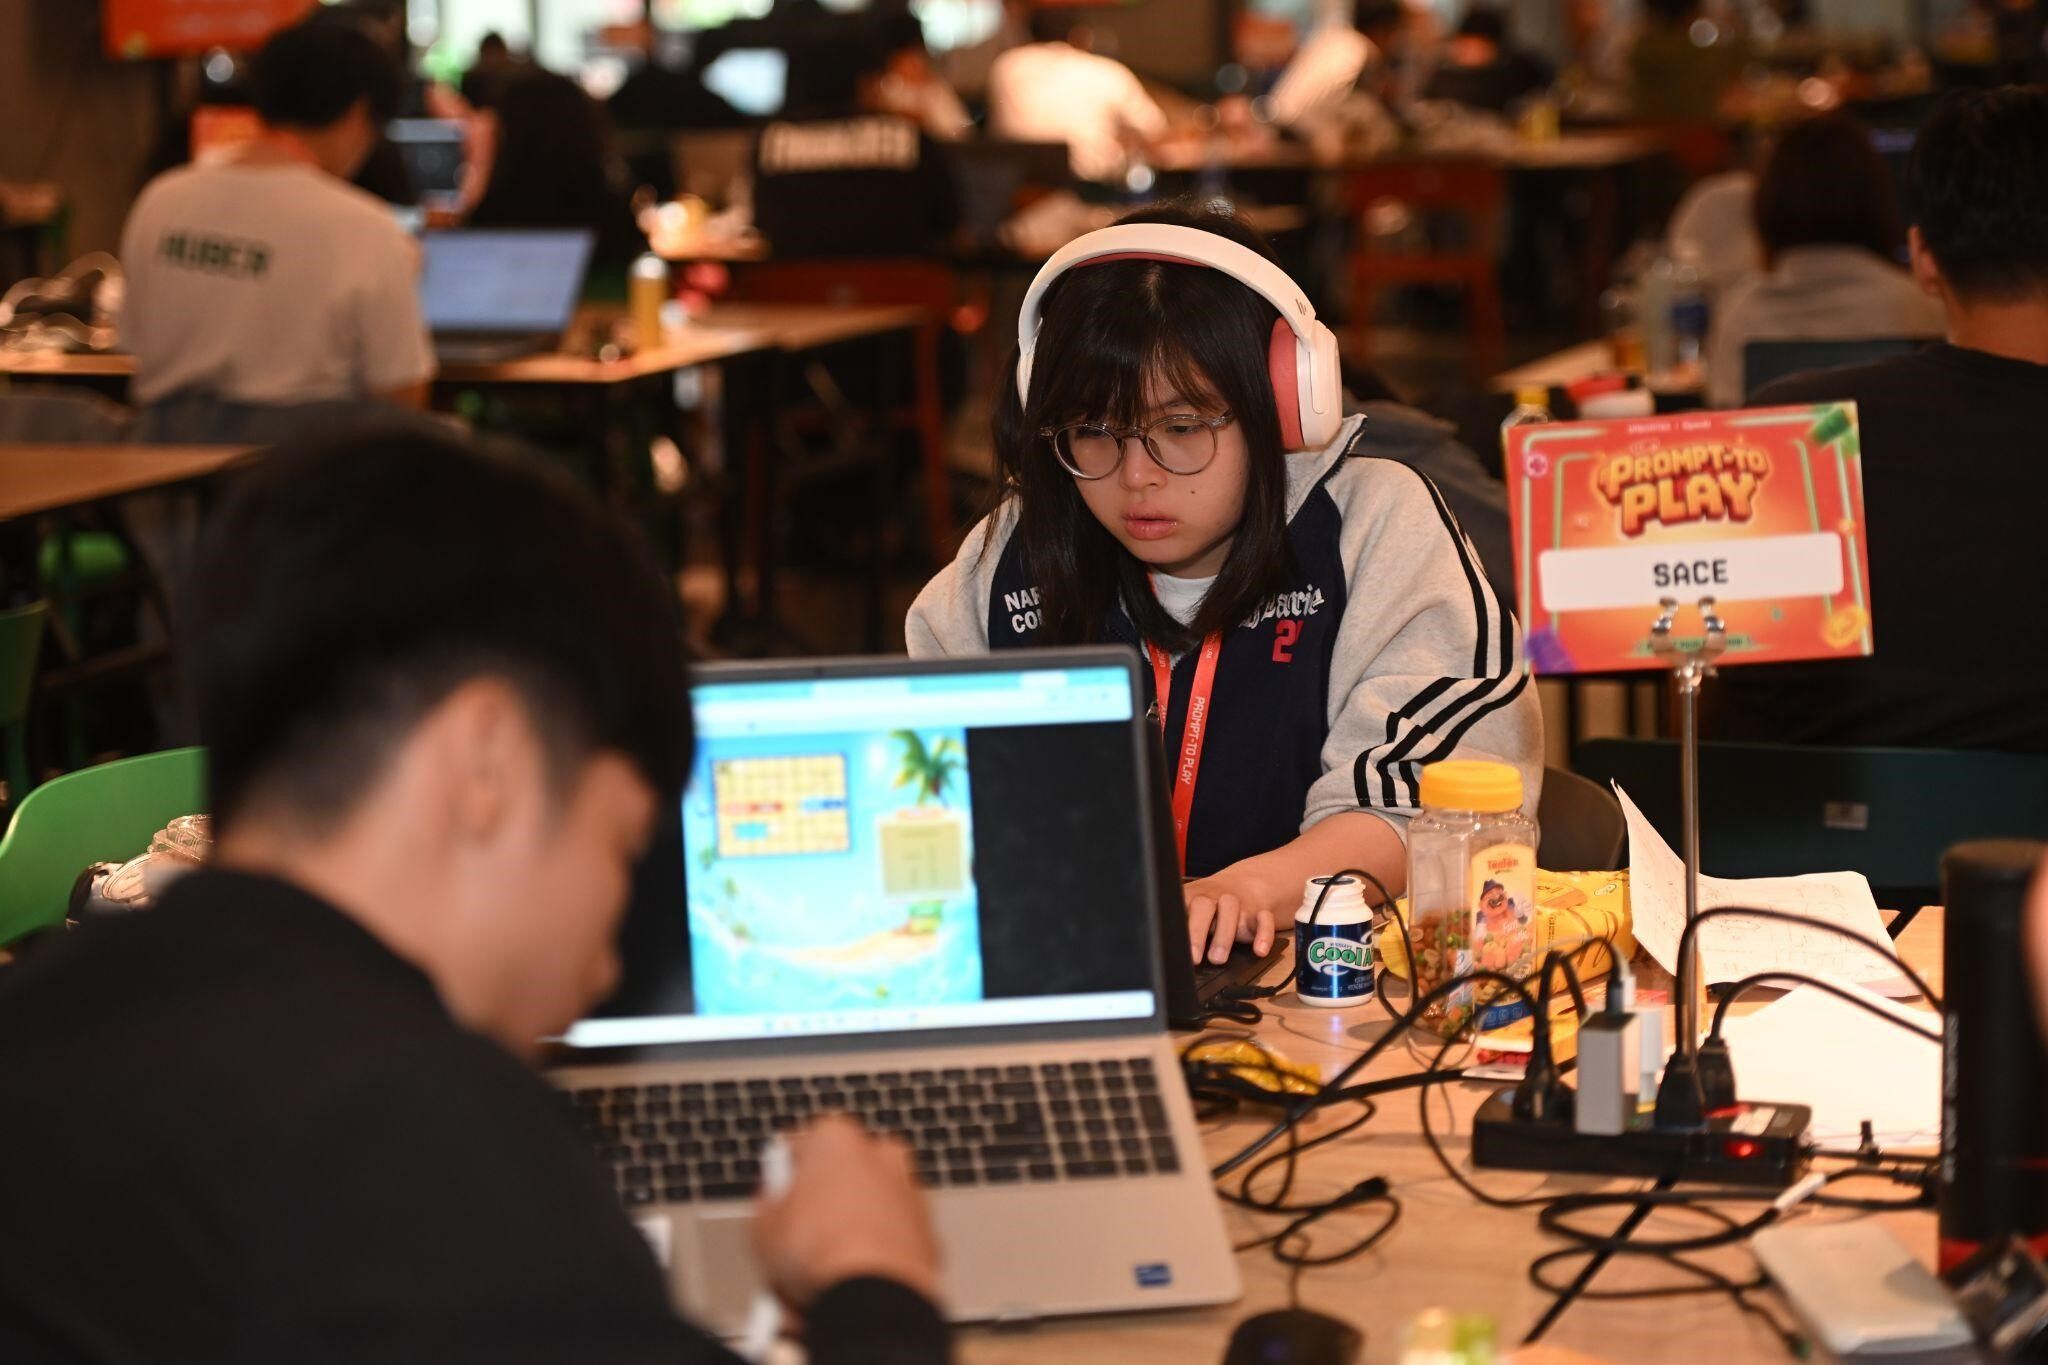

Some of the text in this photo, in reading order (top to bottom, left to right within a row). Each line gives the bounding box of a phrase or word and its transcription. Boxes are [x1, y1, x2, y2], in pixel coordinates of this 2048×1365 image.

[1598, 443, 1769, 506] PROMPT-TO
[1621, 471, 1757, 538] PLAY
[1653, 559, 1728, 588] SACE
[1180, 695, 1206, 785] PROMPT-TO PLAY
